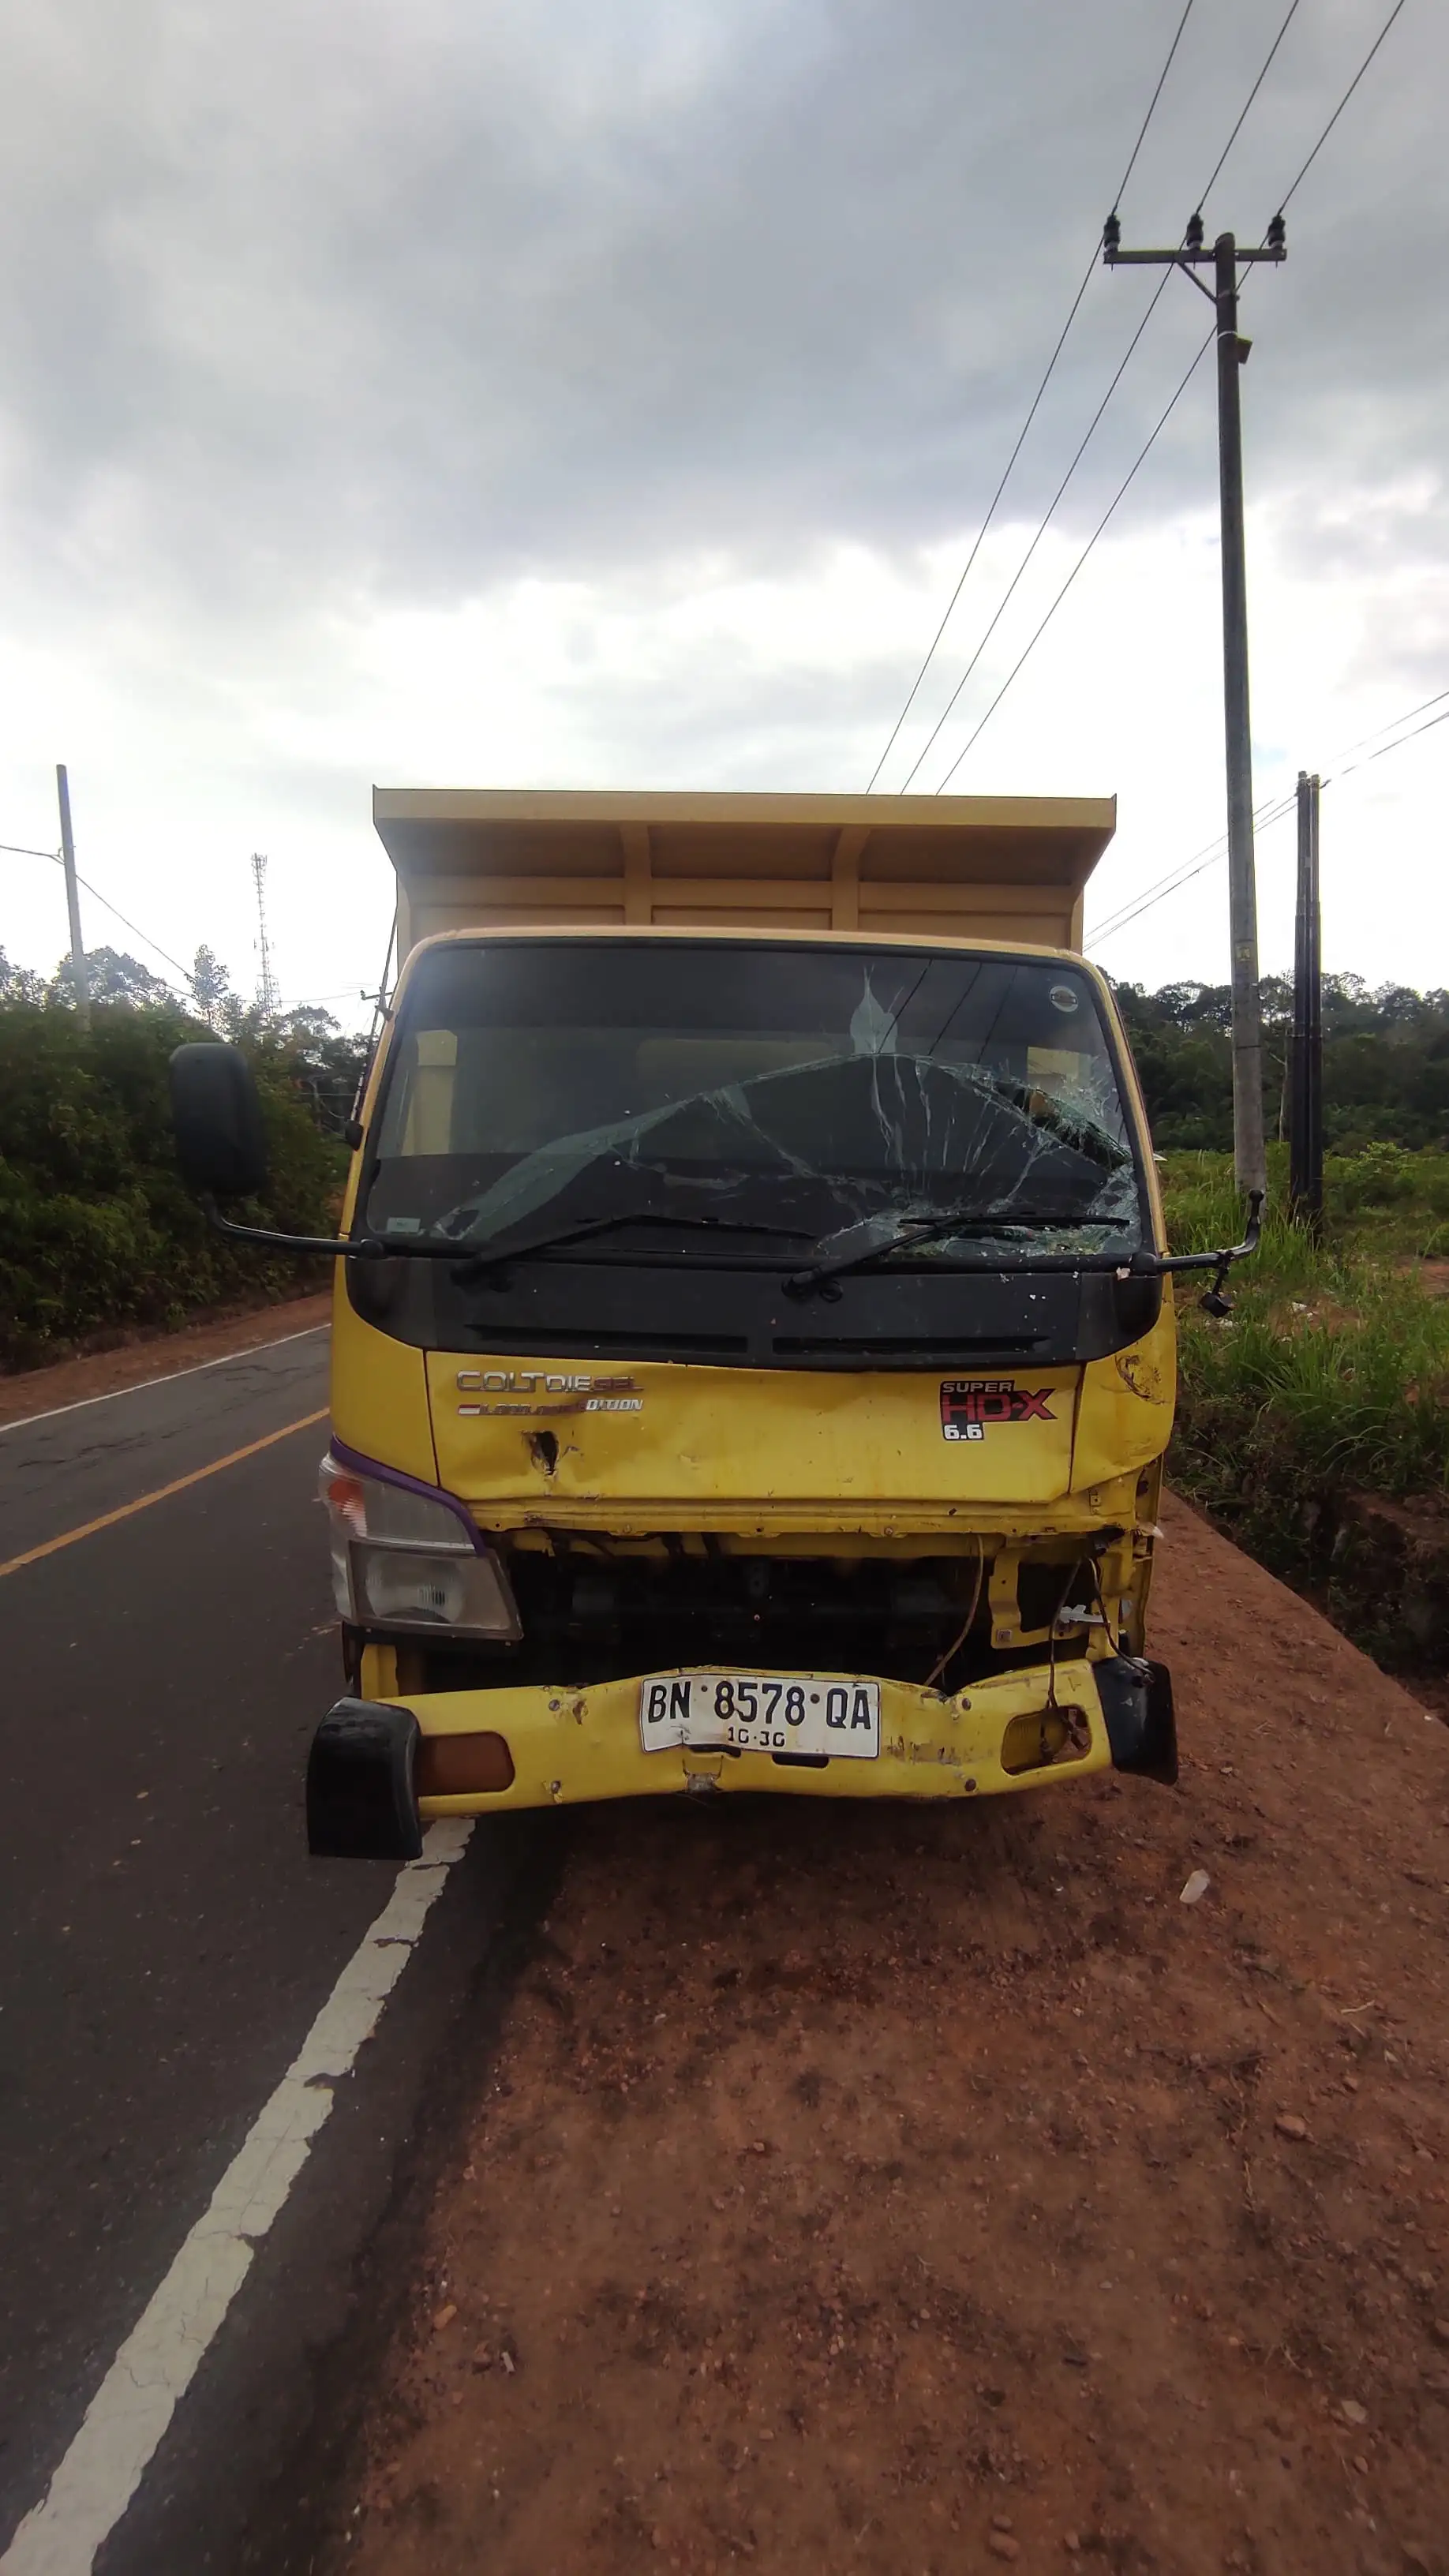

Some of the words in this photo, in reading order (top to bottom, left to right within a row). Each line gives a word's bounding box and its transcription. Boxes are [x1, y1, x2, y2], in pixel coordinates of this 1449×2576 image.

[942, 1382, 1012, 1393] SUPER
[944, 1424, 983, 1440] 6.6
[648, 1681, 691, 1723] BN
[714, 1680, 805, 1726] 8578
[826, 1687, 871, 1730] QA
